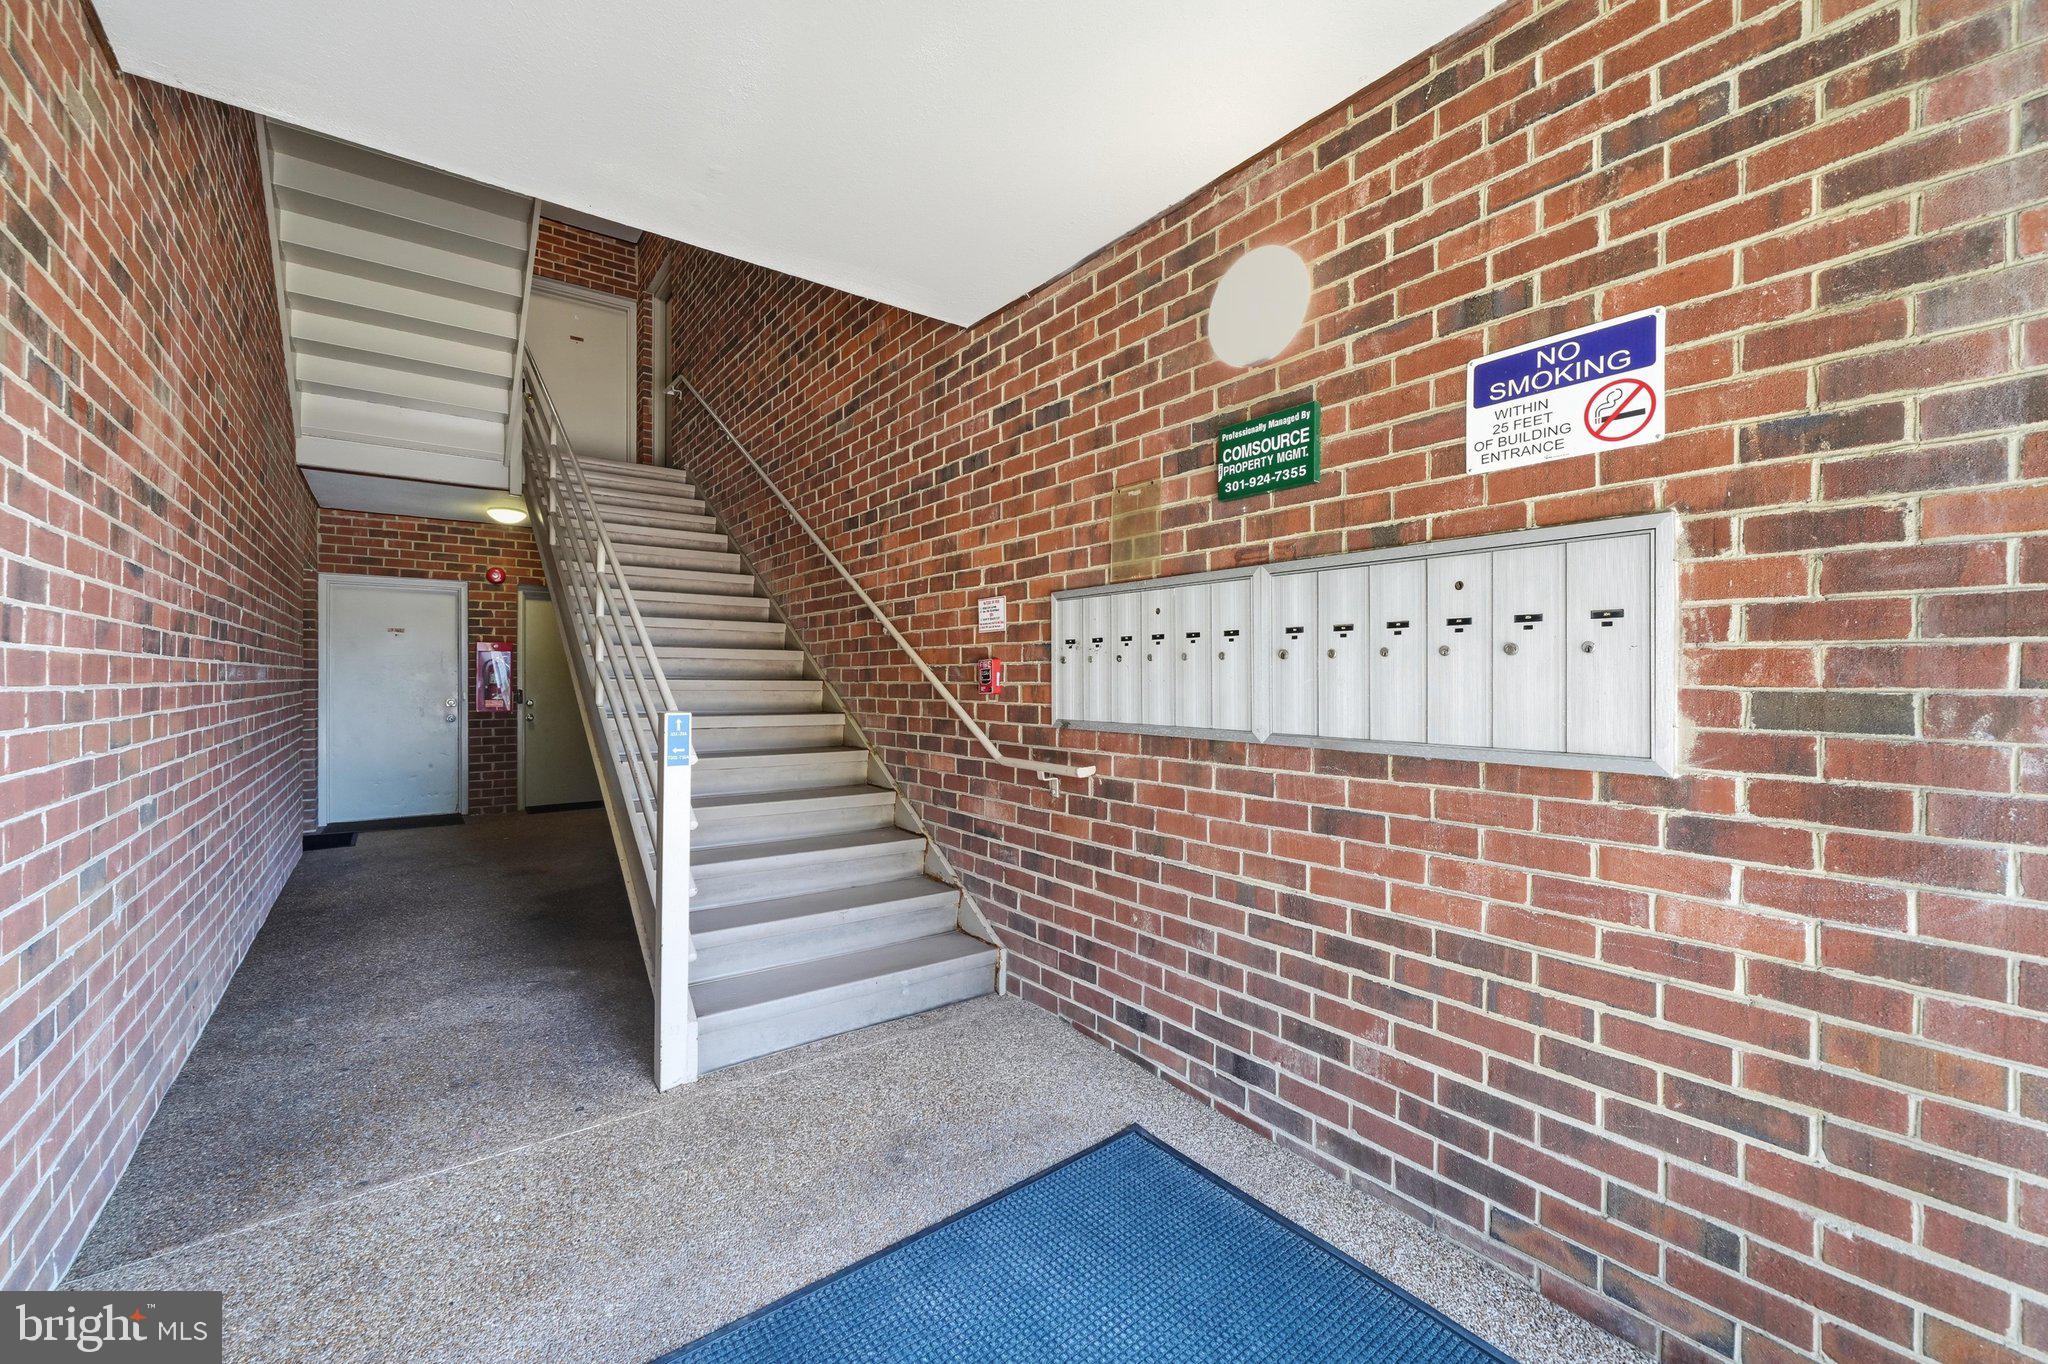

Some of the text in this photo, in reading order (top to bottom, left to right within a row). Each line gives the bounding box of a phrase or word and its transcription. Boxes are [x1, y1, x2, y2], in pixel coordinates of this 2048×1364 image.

[1537, 341, 1581, 368] NO
[1489, 350, 1631, 401] SMOKING
[1492, 412, 1553, 435] 25 FEET
[1494, 399, 1549, 420] WITHIN
[1222, 410, 1311, 442] Professionally Managed By
[1474, 422, 1572, 452] OF BUILDING
[1222, 427, 1310, 463] COMSOURCE
[1481, 438, 1565, 465] ENTRANCE
[1223, 454, 1274, 477] PROPERTY
[1276, 446, 1309, 463] MGMT.
[1225, 465, 1307, 493] 301-924-7355
